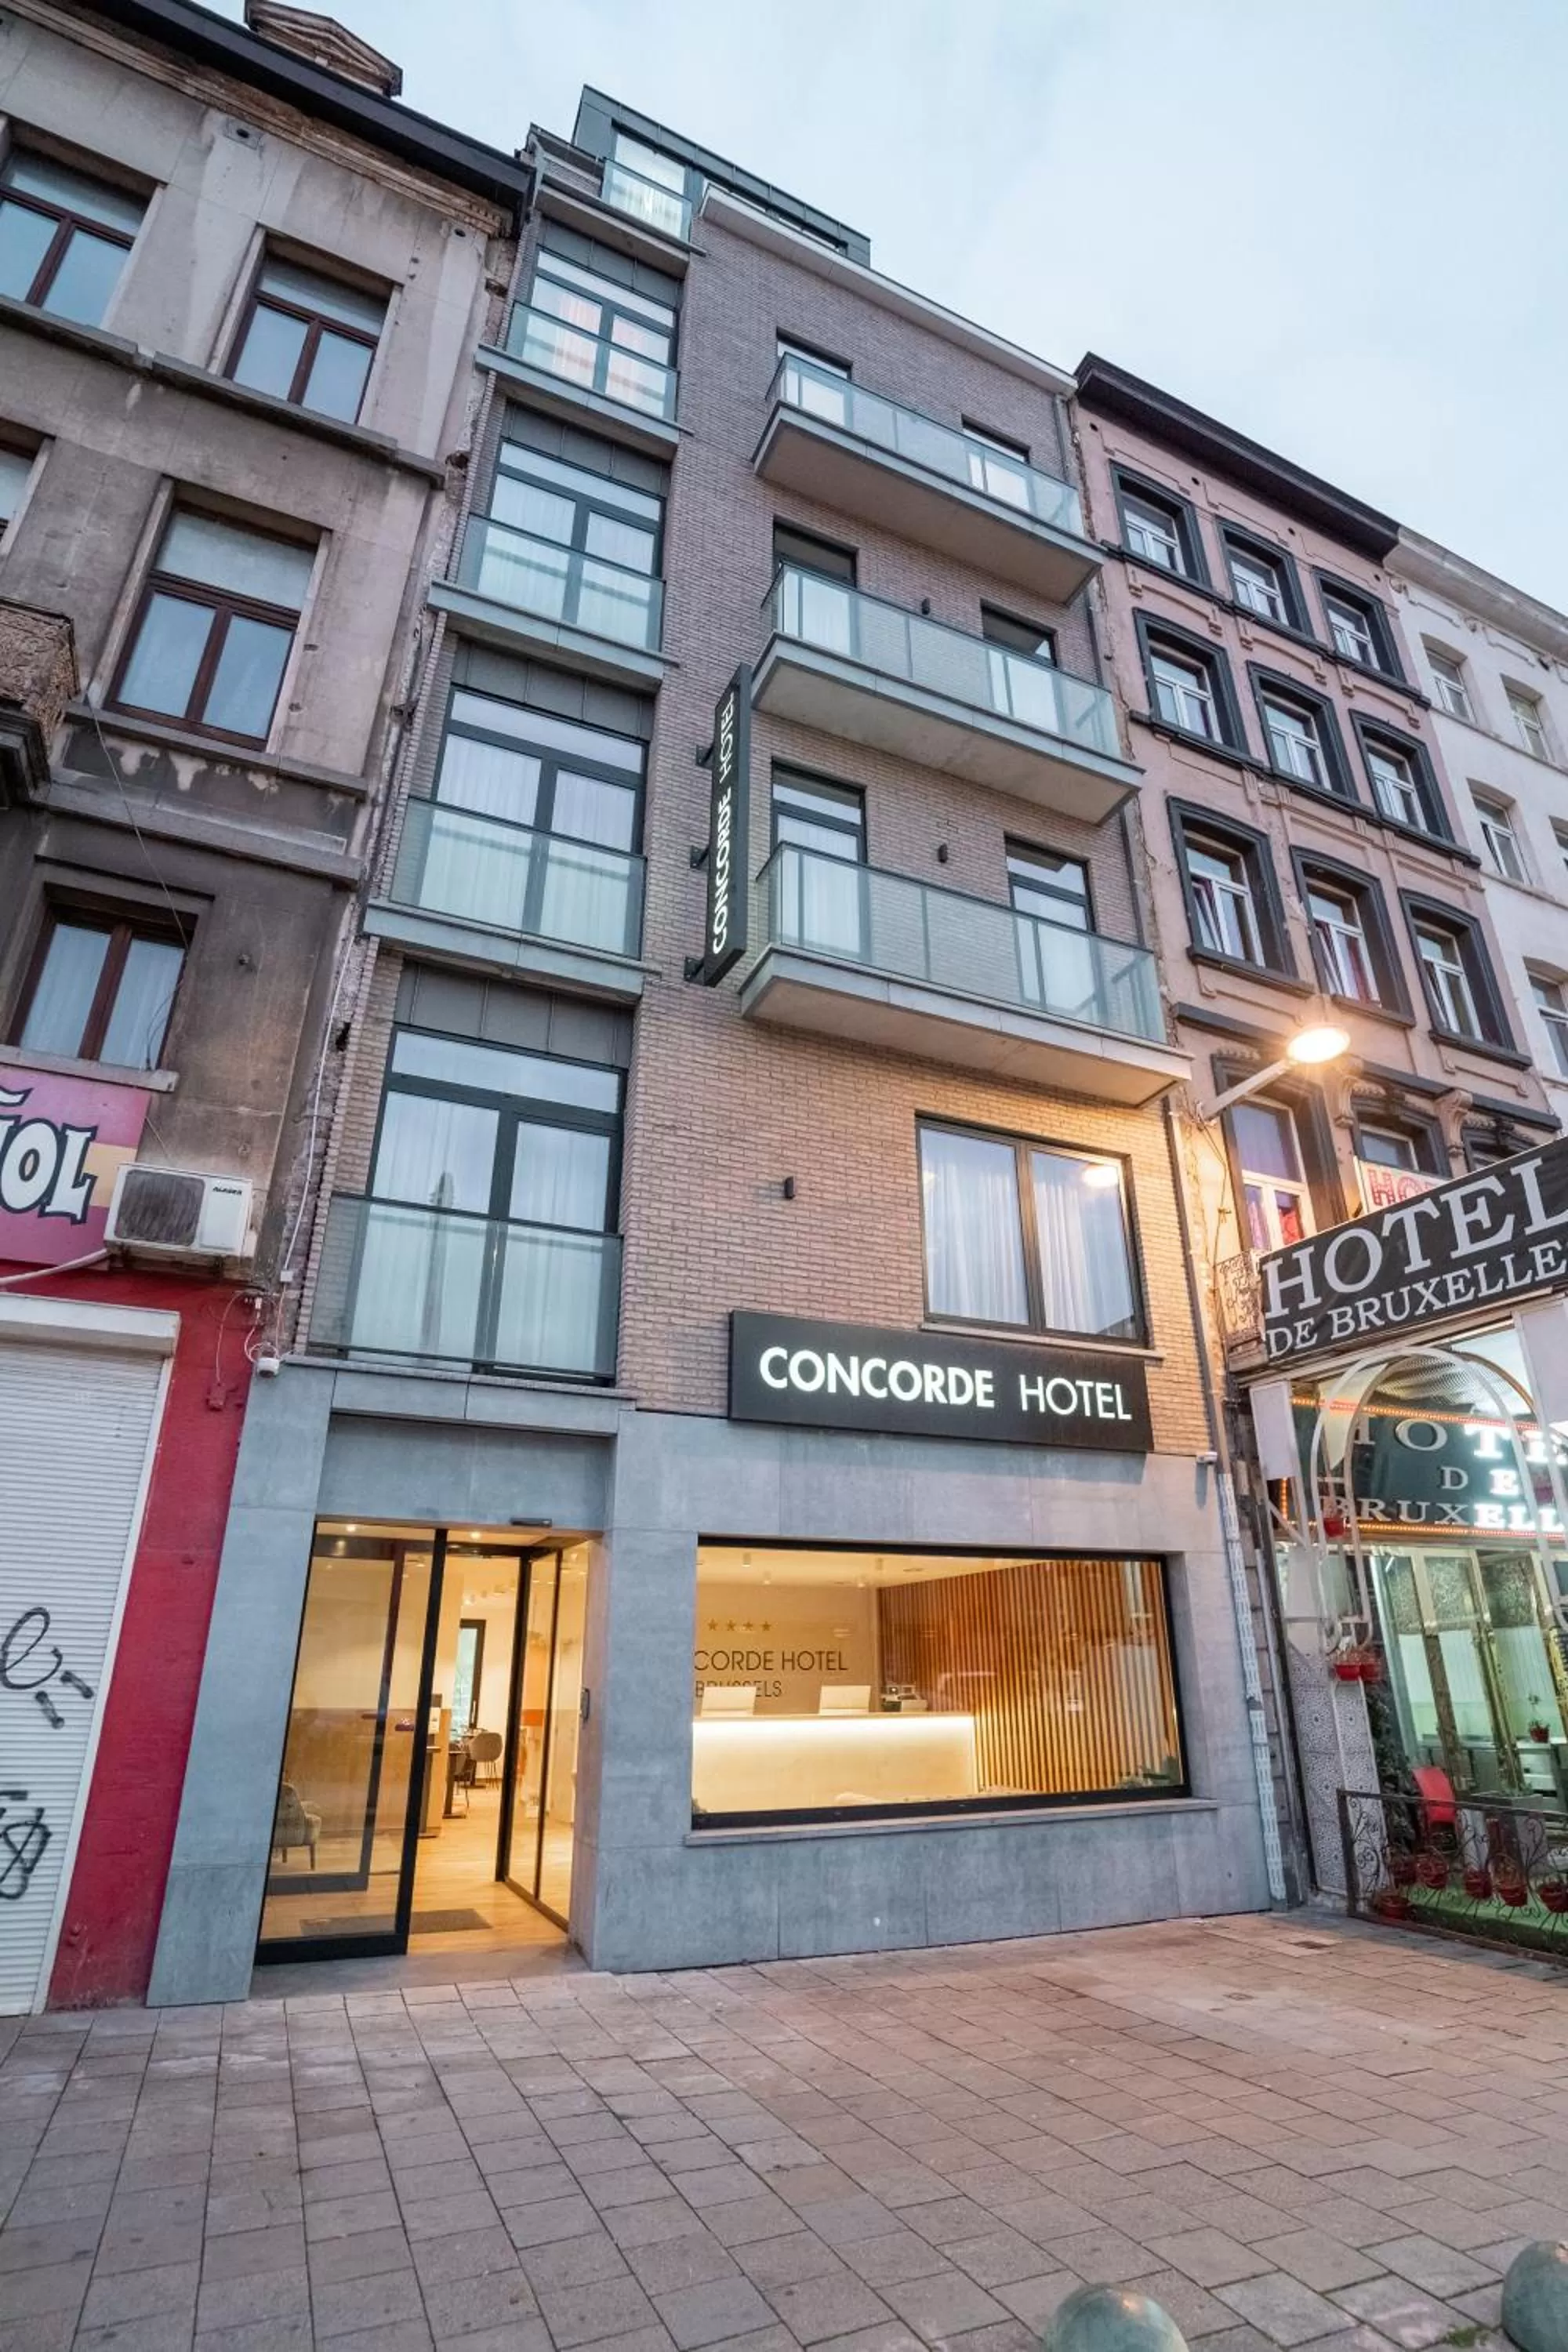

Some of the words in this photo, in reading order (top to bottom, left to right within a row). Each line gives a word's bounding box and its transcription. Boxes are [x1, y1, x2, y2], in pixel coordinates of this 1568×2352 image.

[719, 691, 735, 783] HOTEL
[713, 787, 731, 954] CONCORDE
[0, 1085, 99, 1226] OL
[1367, 1169, 1435, 1205] HO
[1262, 1157, 1568, 1320] HOTEL
[1267, 1317, 1318, 1358] DE
[759, 1346, 995, 1408] CONCORDE
[1019, 1374, 1132, 1421] HOTEL
[1441, 1467, 1519, 1495] DE
[694, 1650, 774, 1671] CORDE
[781, 1650, 849, 1671] HOTEL
